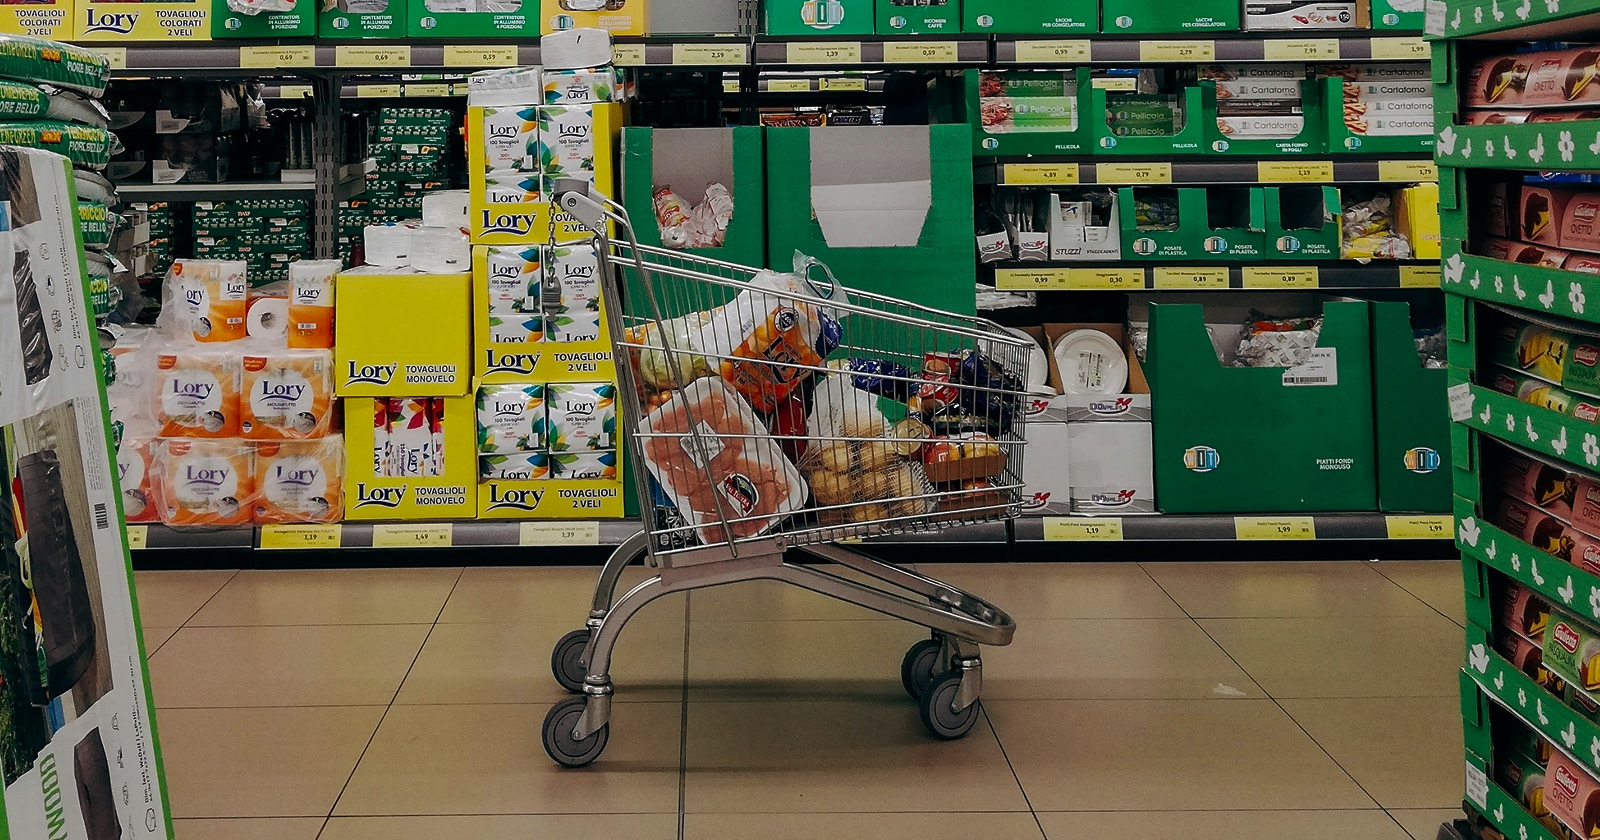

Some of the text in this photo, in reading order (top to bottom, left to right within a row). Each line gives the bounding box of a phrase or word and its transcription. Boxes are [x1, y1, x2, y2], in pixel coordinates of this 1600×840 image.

[15, 10, 66, 18] TOVAGLIOLI
[155, 10, 206, 18] TOVAGLIOLI
[804, 1, 841, 24] WIT
[20, 19, 61, 27] COLORATI
[84, 8, 140, 35] Lory
[160, 19, 202, 27] COLORATI
[27, 28, 52, 36] 2 VELI
[167, 28, 193, 36] 2 VELI
[711, 52, 724, 60] 2,59
[826, 51, 839, 59] 1,39
[923, 49, 936, 57] 0,59
[280, 54, 293, 62] 0,69
[375, 54, 388, 62] 0,69
[483, 54, 496, 62] 0,59
[1250, 68, 1295, 77] Cartaforno
[1378, 68, 1424, 76] Cartaforno
[1023, 79, 1058, 87] Pellicola
[1380, 86, 1426, 94] Cartaforno
[16, 101, 40, 115] BELLO
[1030, 105, 1065, 113] Pellicola
[1387, 102, 1433, 110] Cartaforno
[1131, 112, 1165, 120] Pellicola
[1253, 121, 1299, 129] Cartaforno
[1388, 120, 1434, 128] Cartaforno
[489, 124, 520, 139] Lory
[558, 123, 589, 139] Lory
[1131, 127, 1165, 135] Pellicola
[1043, 171, 1057, 179] 4,89
[1136, 171, 1149, 179] 0,79
[492, 192, 522, 202] Lory
[88, 222, 107, 233] BELLO
[479, 209, 537, 238] Lory
[563, 224, 569, 232] 2
[490, 264, 521, 279] Lory
[563, 264, 595, 279] Lory
[1282, 275, 1296, 283] 0,89
[226, 283, 245, 296] Lory
[297, 287, 321, 299] Lory
[553, 352, 612, 362] TOVAGLIOLI
[484, 349, 541, 378] Lory
[567, 363, 597, 372] 2 VELI
[405, 365, 456, 373] TOVAGLIOLI
[345, 360, 398, 387] Lory
[406, 375, 455, 383] MONOVELO
[173, 379, 215, 400] Lory
[261, 381, 306, 402] Lory
[494, 401, 526, 416] Lory
[565, 400, 596, 416] Lory
[408, 448, 421, 474] Lory
[1186, 449, 1217, 469] WIT
[1406, 450, 1437, 470] WIT
[186, 465, 229, 486] Lory
[276, 465, 318, 485] Lory
[415, 486, 466, 496] TOVAGLIOLI
[558, 488, 617, 498] TOVAGLIOLI
[353, 483, 406, 510] Lory
[486, 484, 545, 512] Lory
[415, 497, 465, 505] MONOVELO
[572, 499, 601, 508] 2 VELI
[1085, 527, 1099, 535] 1,19
[1277, 526, 1291, 534] 1,99
[1429, 525, 1443, 533] 1,99
[304, 533, 318, 541] 1,19
[415, 533, 429, 541] 1,49
[561, 531, 575, 539] 1,39
[1552, 787, 1574, 811] OVETTO
